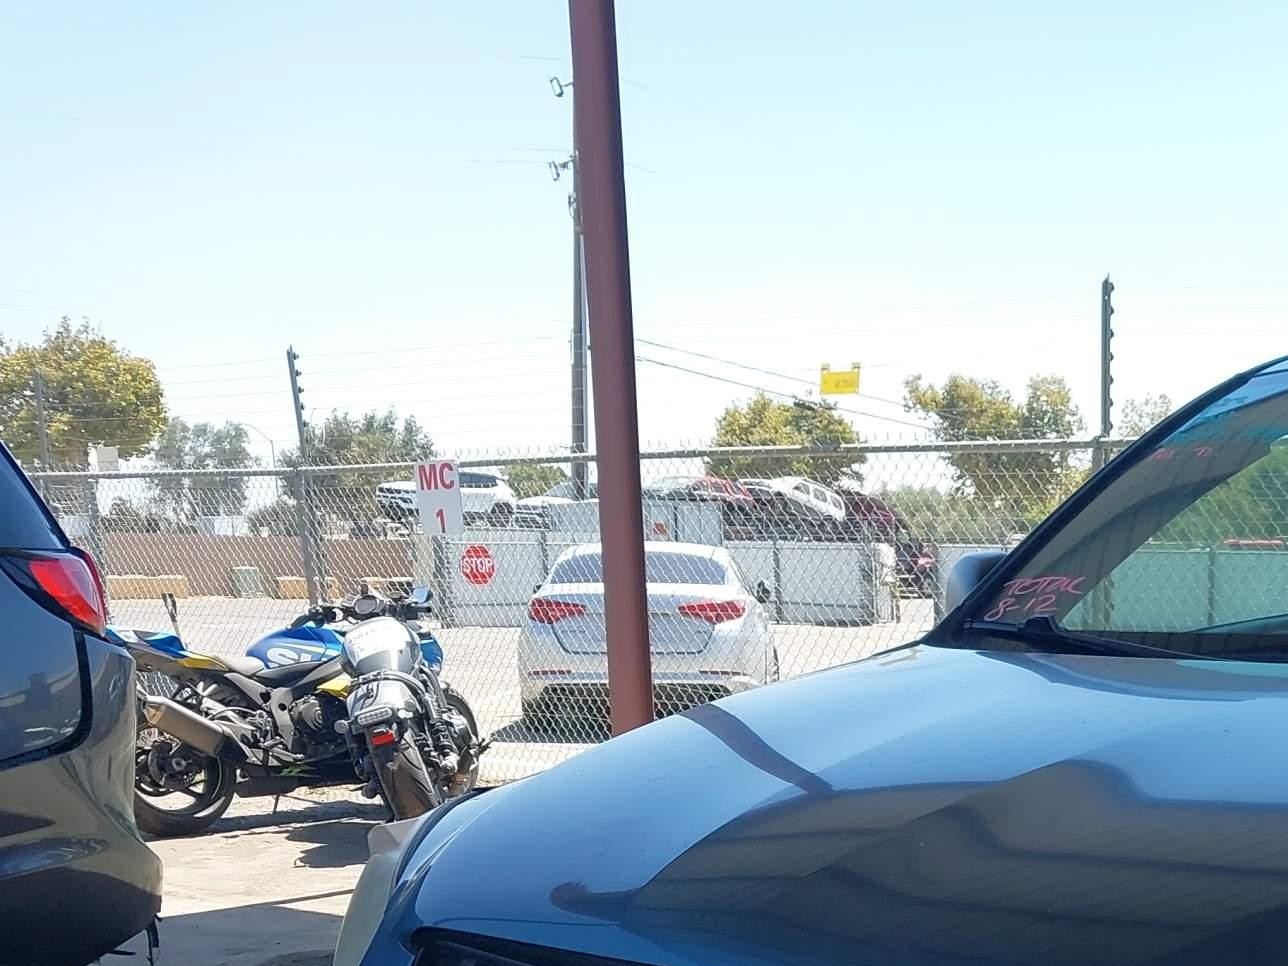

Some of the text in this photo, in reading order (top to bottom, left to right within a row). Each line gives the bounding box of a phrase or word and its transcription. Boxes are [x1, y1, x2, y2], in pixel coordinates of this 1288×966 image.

[418, 462, 455, 491] MC
[435, 508, 446, 534] 1
[462, 557, 494, 573] STOP
